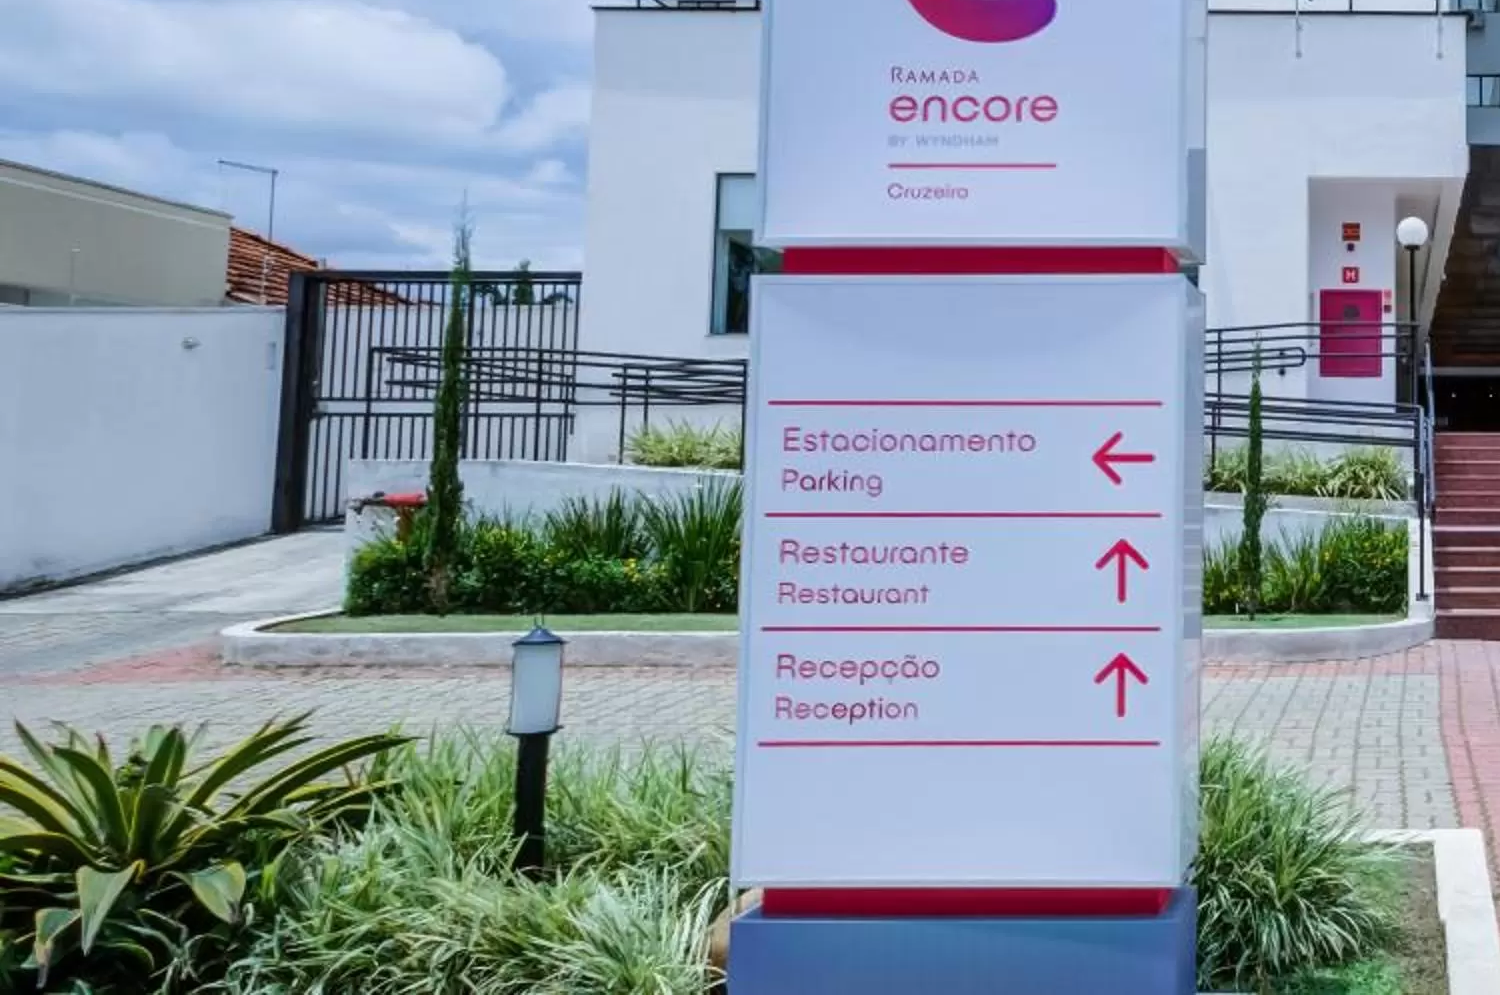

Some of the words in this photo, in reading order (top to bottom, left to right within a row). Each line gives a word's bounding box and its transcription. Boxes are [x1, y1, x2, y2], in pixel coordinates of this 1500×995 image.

[890, 65, 979, 85] RAMADA
[888, 94, 1060, 124] encore
[887, 134, 908, 149] BY
[915, 134, 1000, 149] WYNDHAM
[887, 182, 969, 200] Cruzeiro
[783, 426, 1037, 453] Estacionamento
[781, 468, 883, 498] Parking
[779, 538, 969, 565] Restaurante
[778, 581, 930, 605] Restaurant
[776, 653, 940, 686] Recepção
[775, 696, 918, 726] Reception
